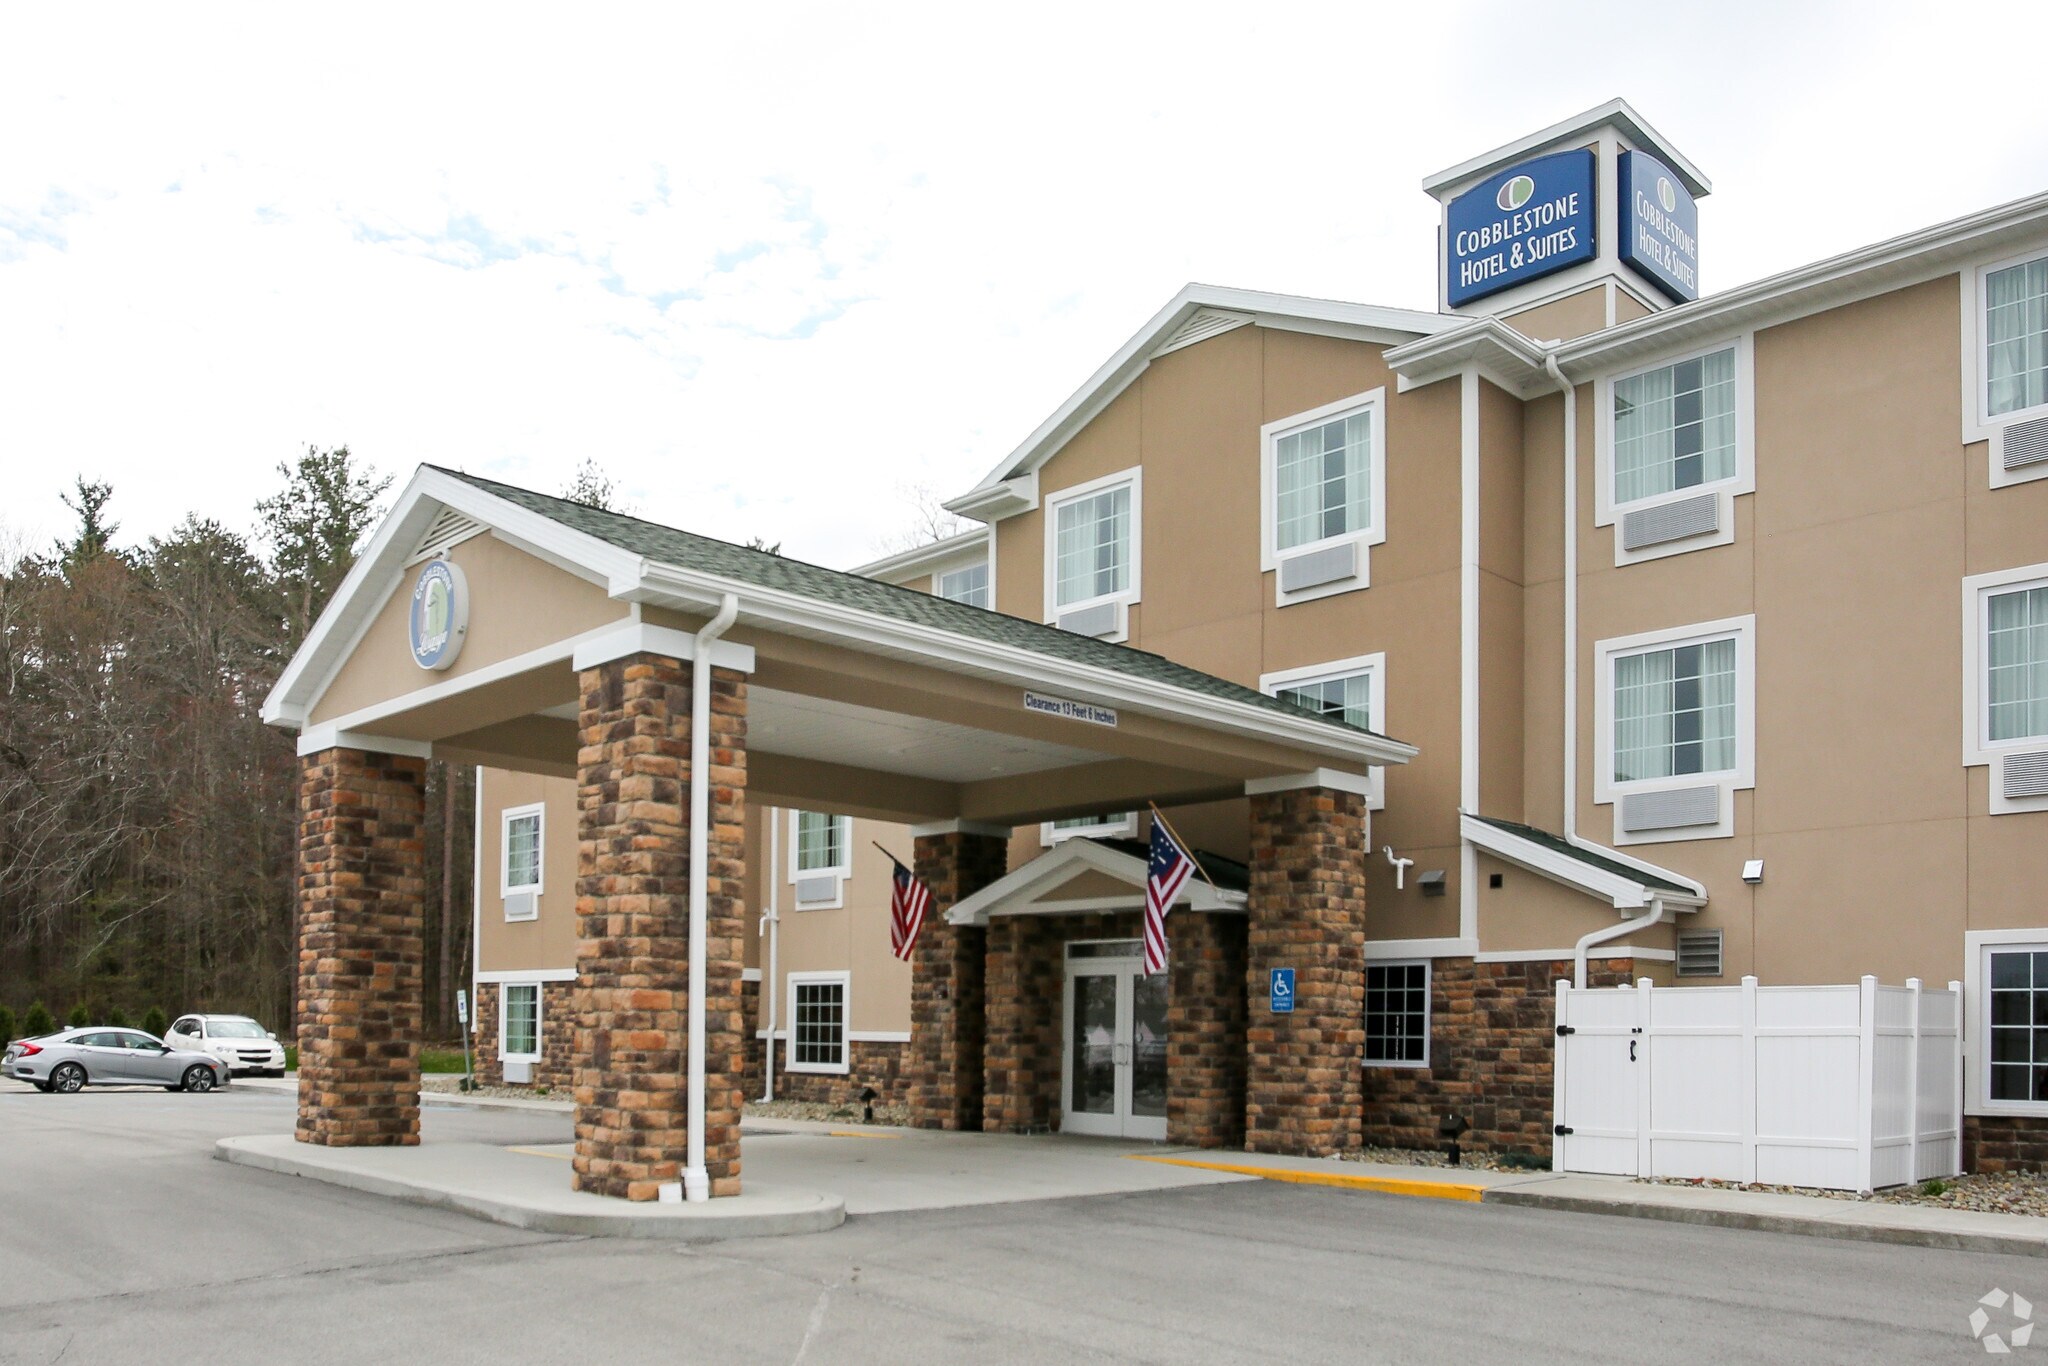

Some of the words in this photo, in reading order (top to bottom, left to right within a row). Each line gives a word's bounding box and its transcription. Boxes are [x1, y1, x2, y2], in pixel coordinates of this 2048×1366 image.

[1456, 192, 1578, 256] COBBLESTONE
[1637, 190, 1695, 260] COBBLESTONE
[1461, 253, 1507, 287] HOTEL
[1510, 242, 1524, 268] &
[1527, 226, 1577, 263] SUITES
[1639, 223, 1663, 266] HOTEL
[1664, 244, 1671, 272] &
[1672, 251, 1694, 290] SUITES
[1025, 693, 1060, 713] Clearance
[1062, 702, 1071, 715] 13
[1072, 705, 1087, 719] Feet
[1088, 707, 1093, 720] 6
[1094, 709, 1115, 725] Inches
